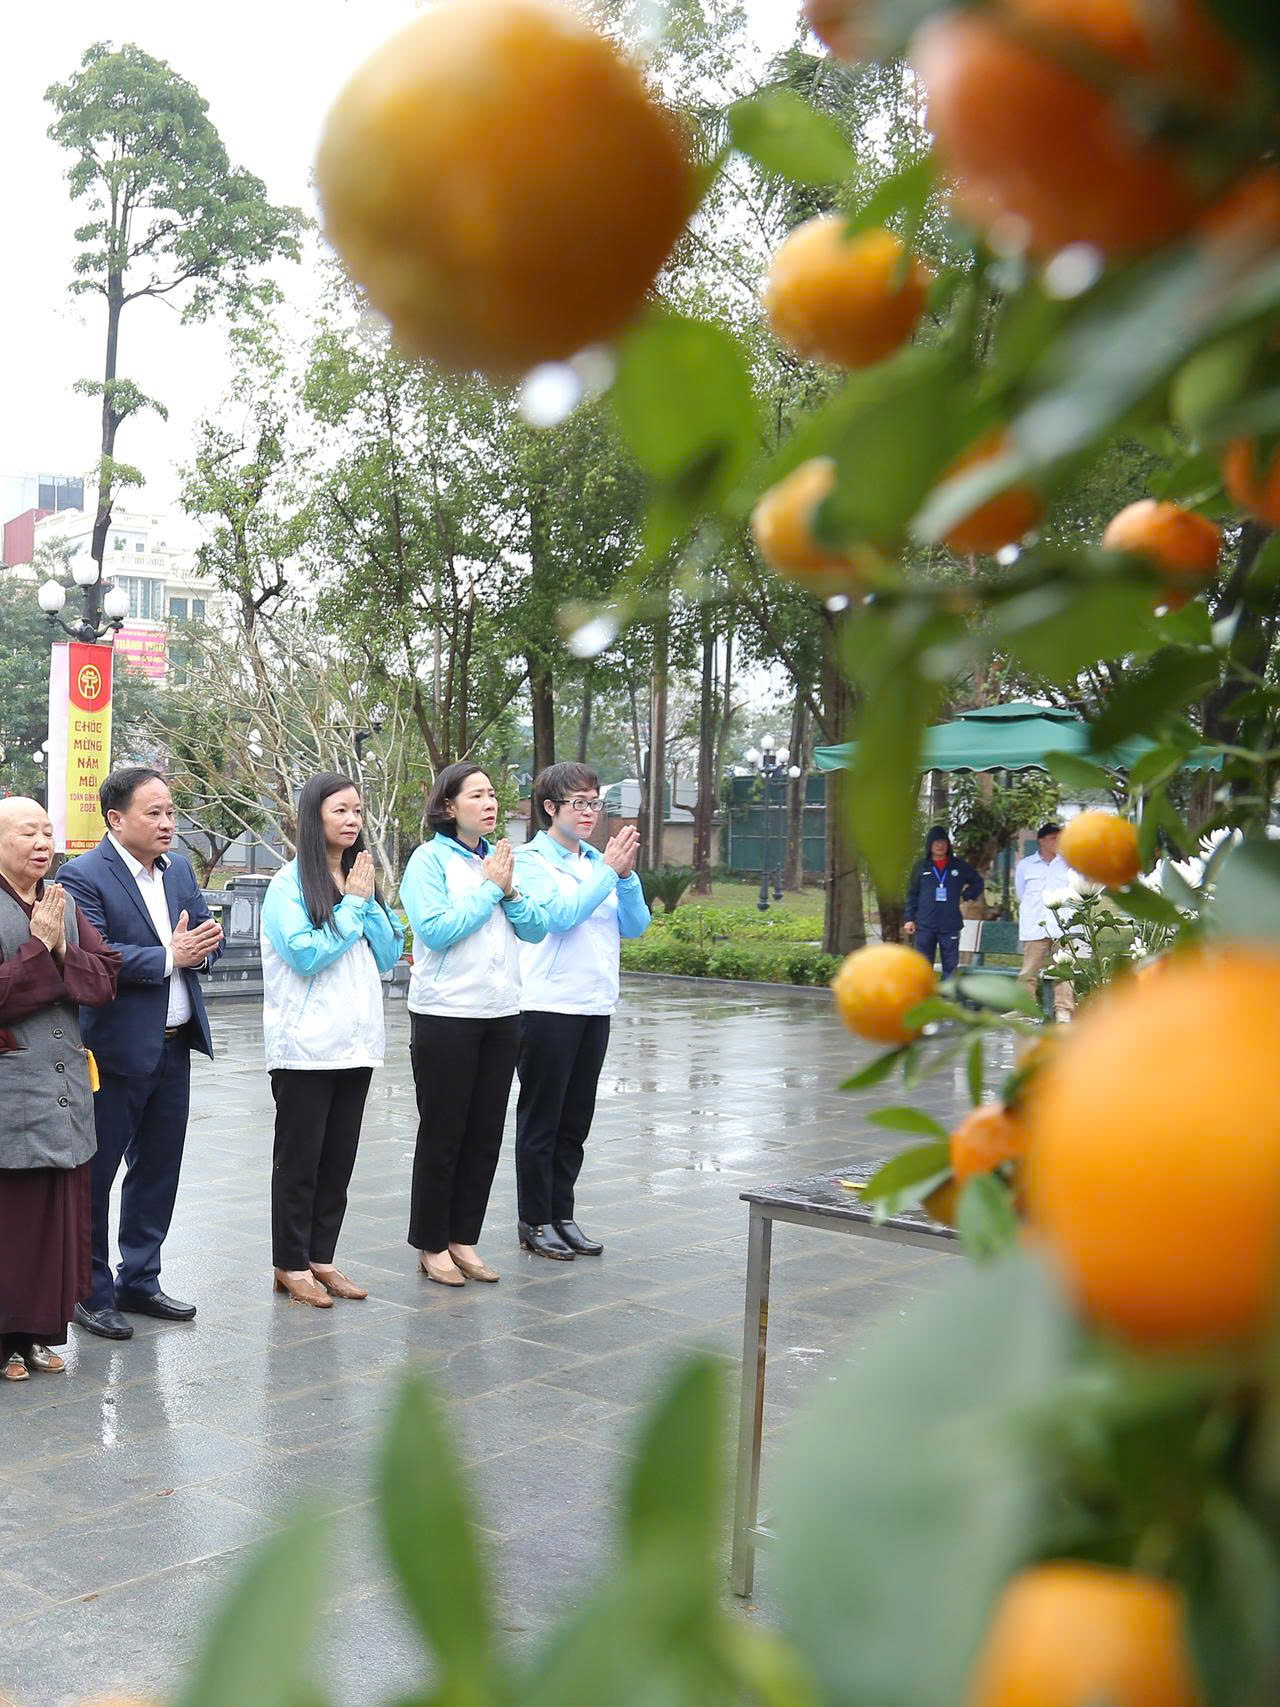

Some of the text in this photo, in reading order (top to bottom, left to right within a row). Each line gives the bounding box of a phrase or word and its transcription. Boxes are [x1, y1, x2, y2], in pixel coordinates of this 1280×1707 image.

[74, 719, 102, 733] CHÚC
[73, 737, 102, 752] MỪNG
[77, 756, 99, 769] NĂM
[80, 803, 97, 813] 2026
